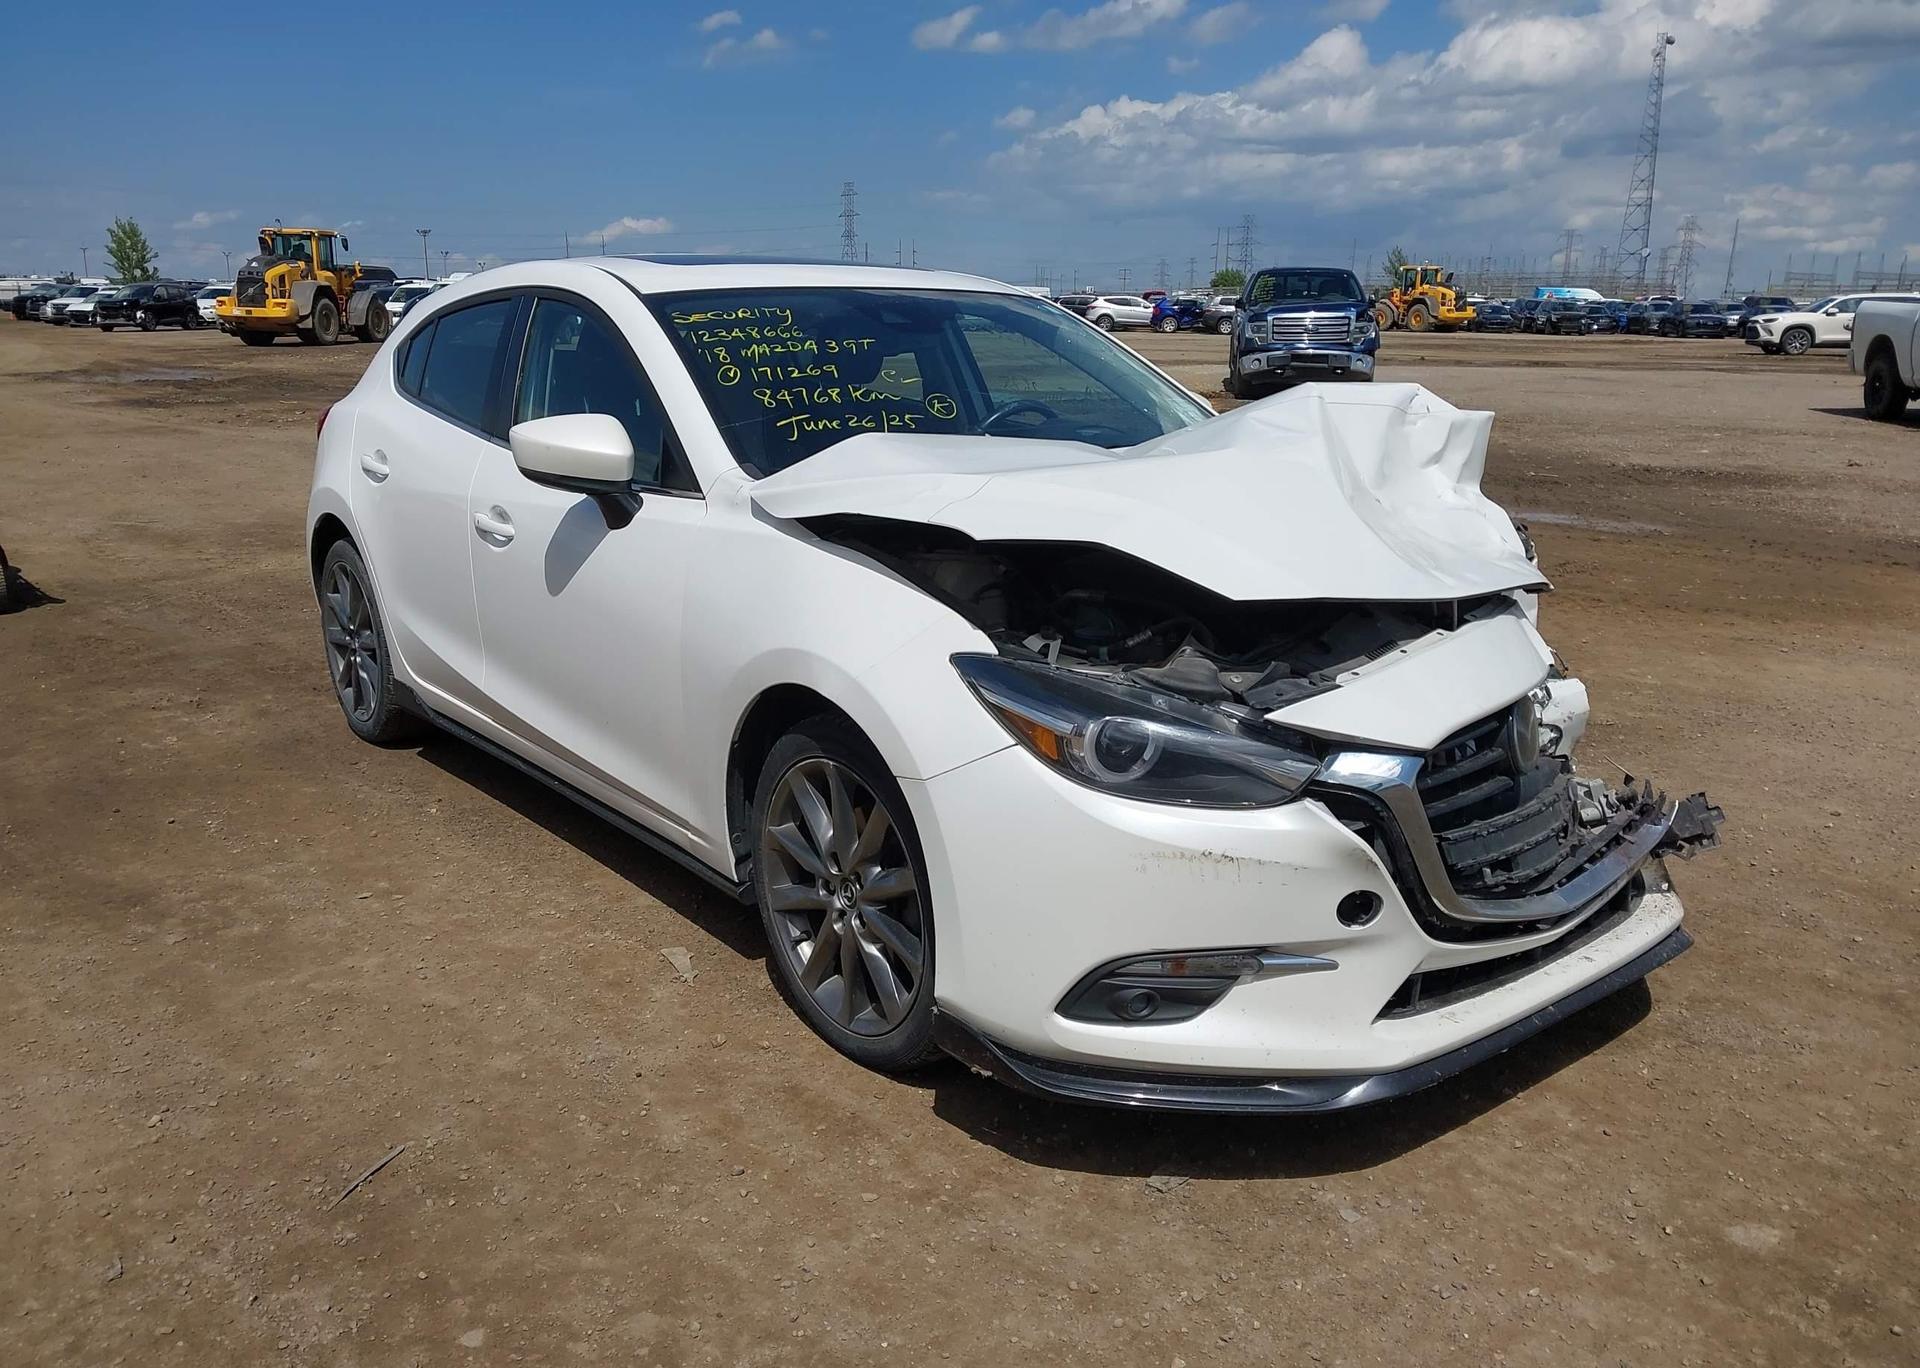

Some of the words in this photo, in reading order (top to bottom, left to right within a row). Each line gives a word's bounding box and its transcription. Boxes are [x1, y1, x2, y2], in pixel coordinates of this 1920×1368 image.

[690, 325, 803, 344] 12348666
[740, 339, 818, 364] MAZDA
[750, 363, 839, 382] 171269
[753, 386, 842, 409] 84768
[776, 414, 842, 441] June
